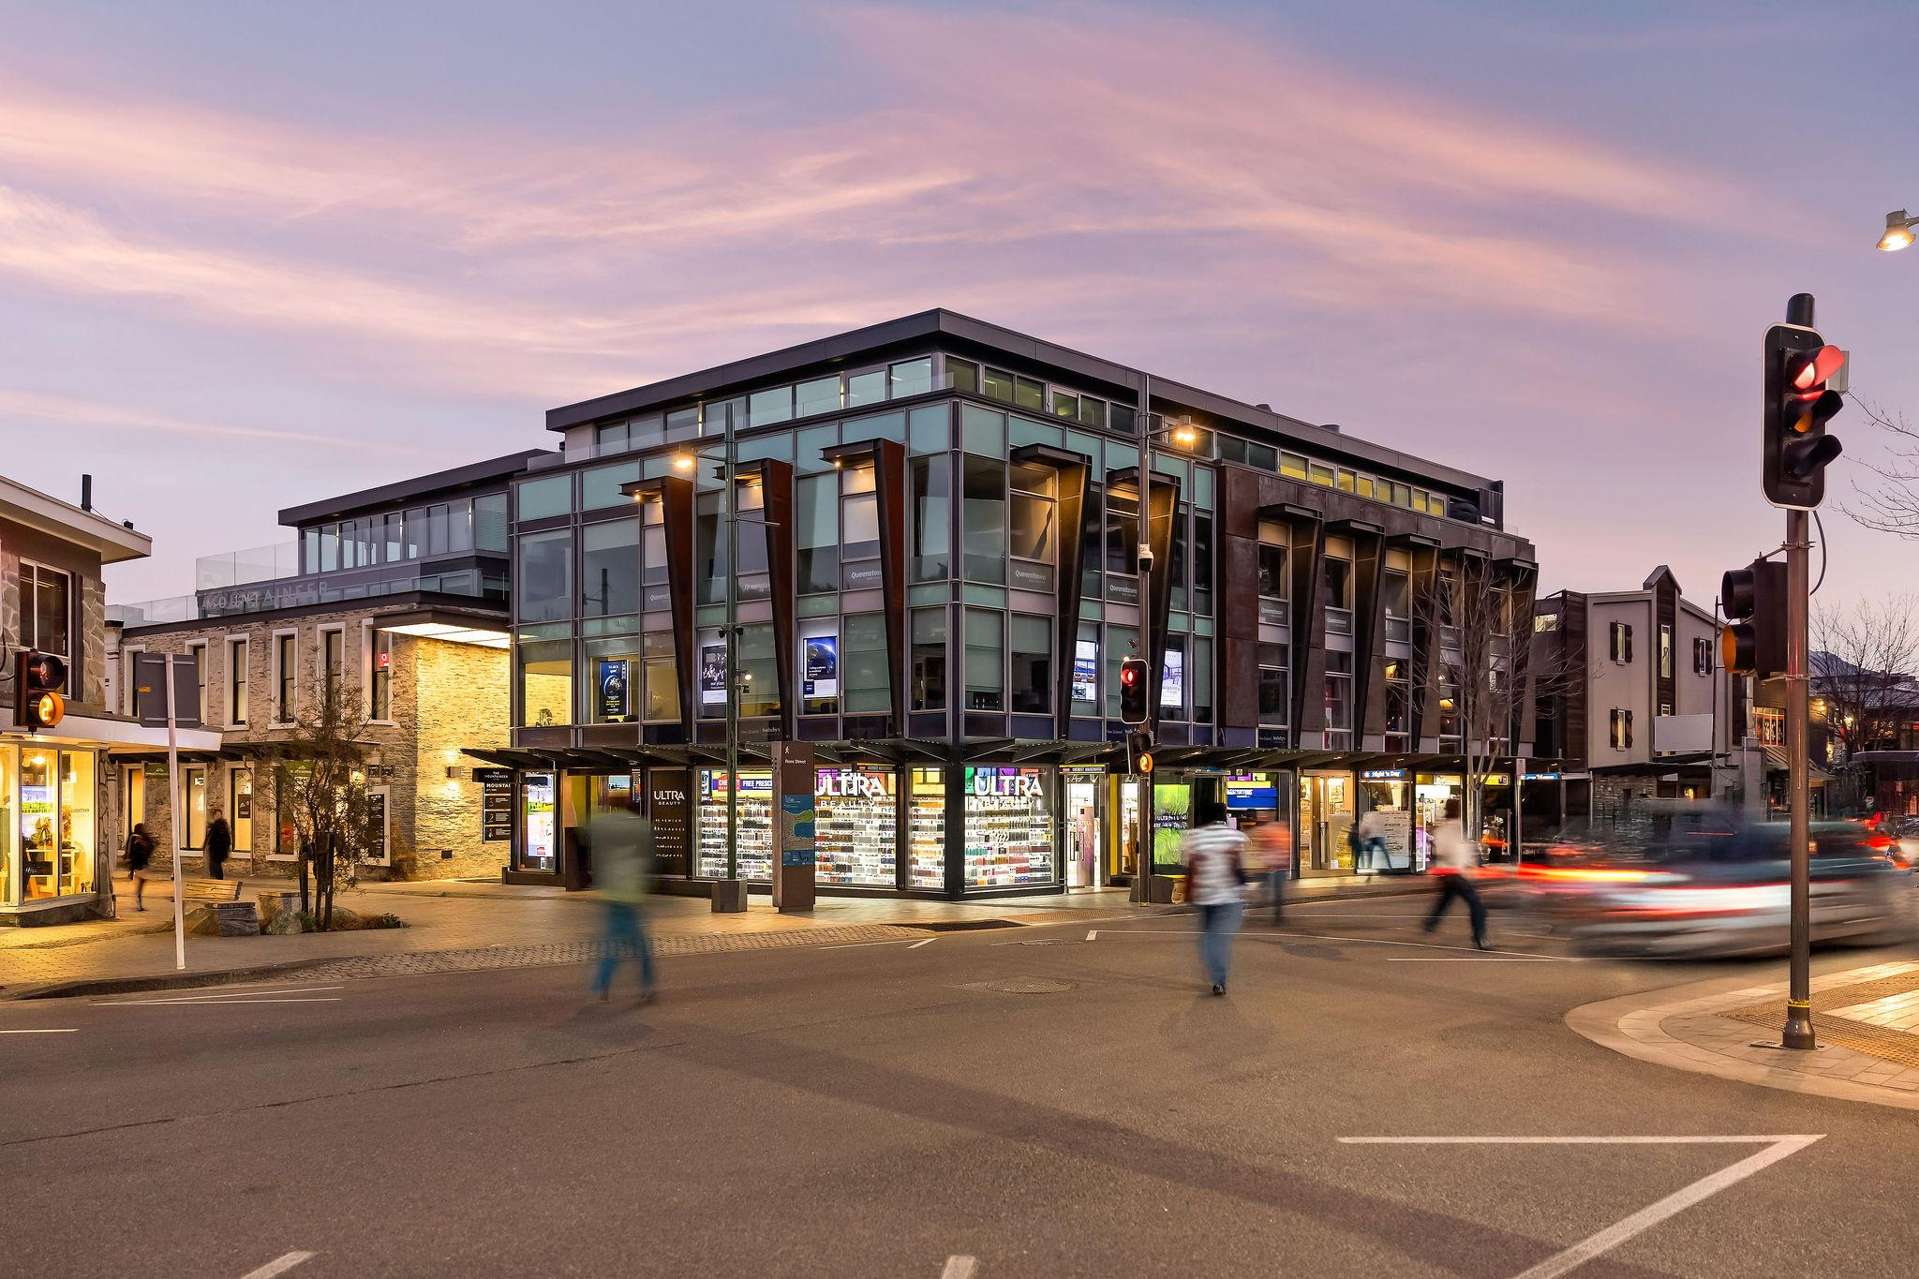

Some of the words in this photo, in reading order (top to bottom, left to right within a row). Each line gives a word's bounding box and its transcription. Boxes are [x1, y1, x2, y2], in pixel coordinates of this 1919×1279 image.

[814, 773, 889, 799] ULTRA
[975, 775, 1044, 798] ULTRA
[653, 790, 685, 801] ULTRA
[820, 800, 876, 808] BEAUTY
